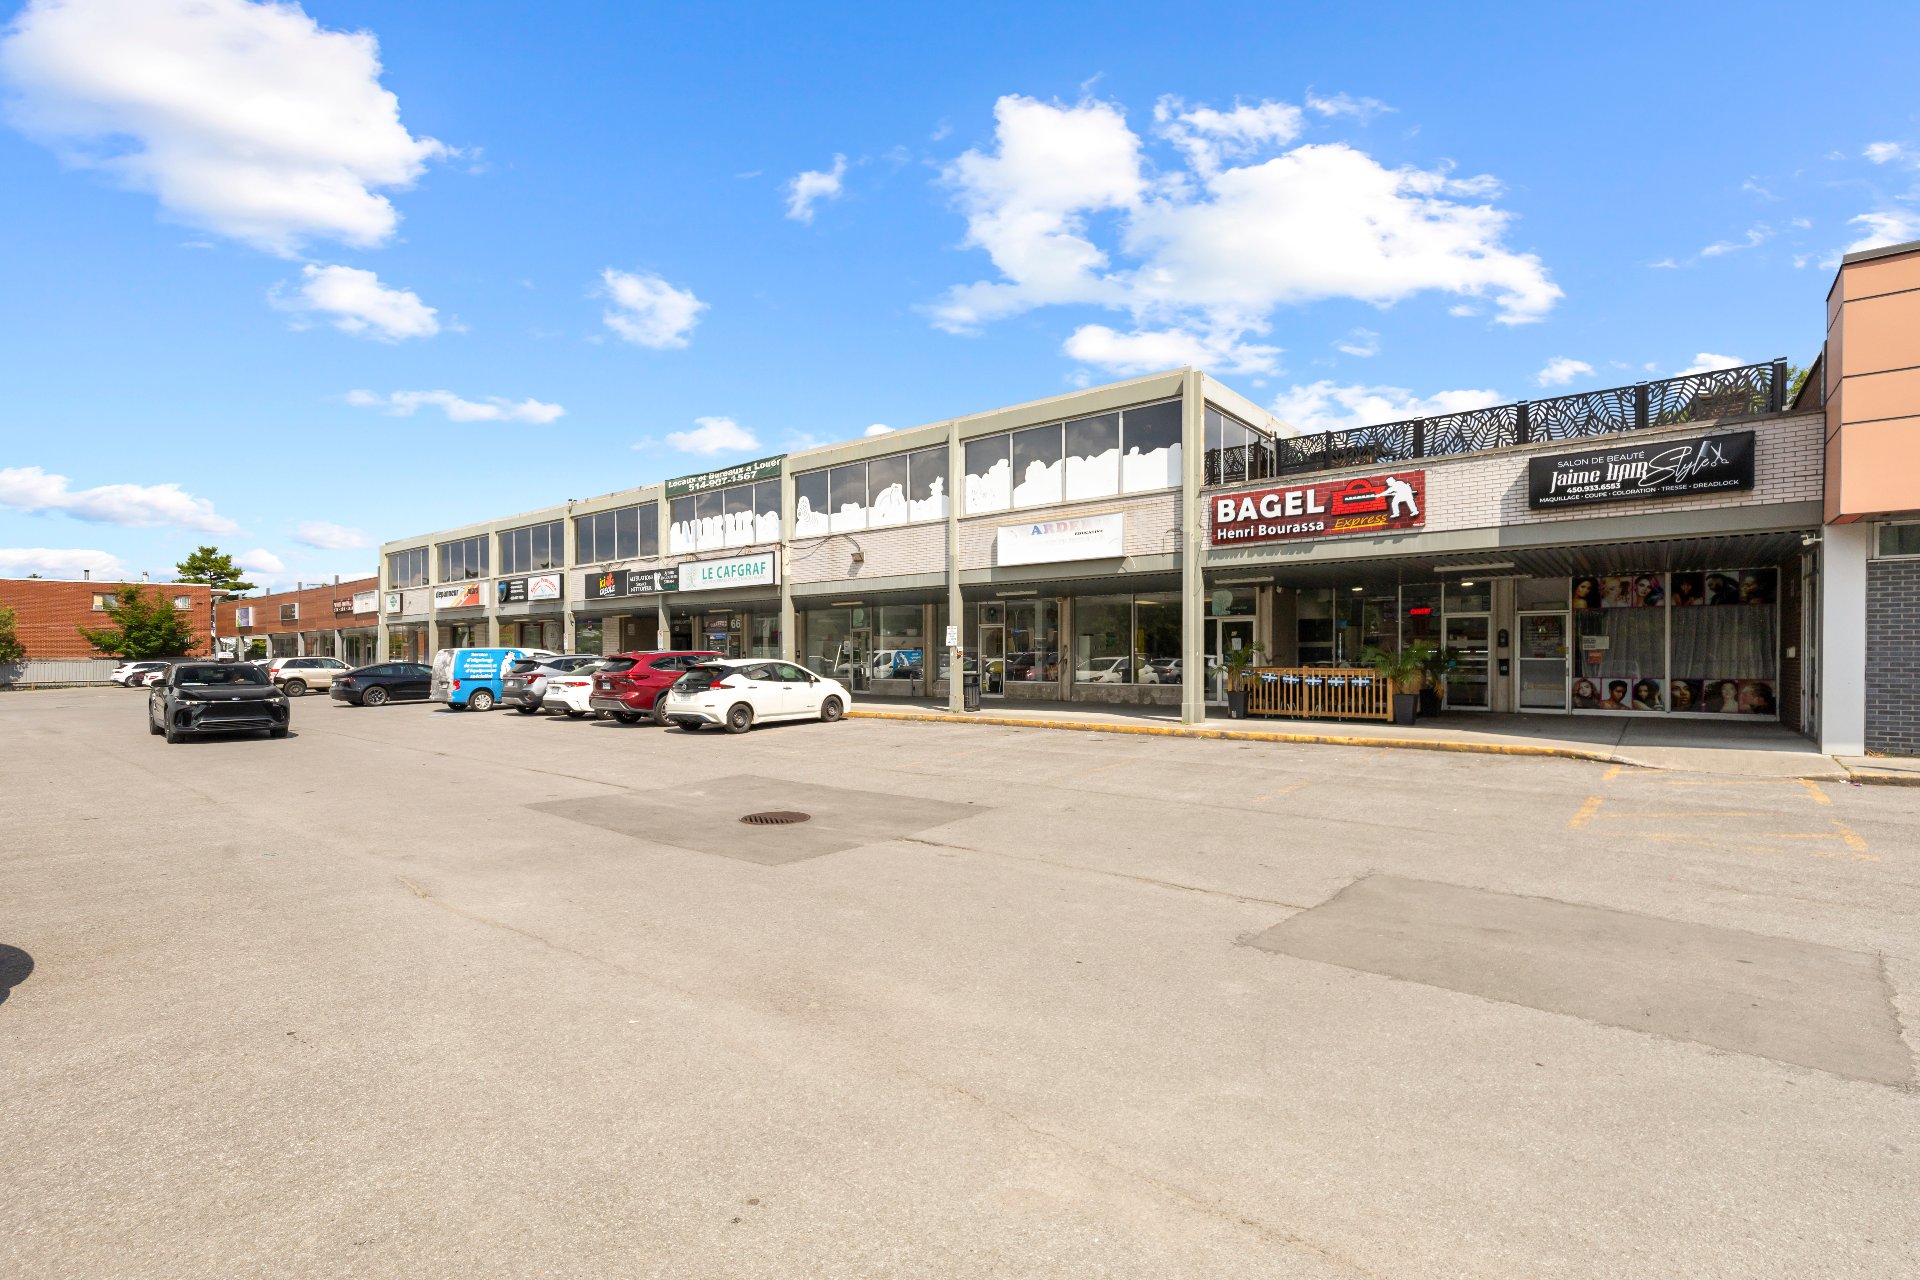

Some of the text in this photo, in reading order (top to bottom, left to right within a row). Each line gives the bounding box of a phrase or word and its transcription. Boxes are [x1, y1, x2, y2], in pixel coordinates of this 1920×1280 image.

[1549, 441, 1711, 493] Jaime HAIR Style
[1557, 450, 1645, 468] SALON DE BEAUTÉ
[668, 477, 696, 489] Locaux
[698, 474, 707, 482] et
[708, 467, 744, 480] Bureaux
[754, 459, 781, 471] Louer
[1539, 479, 1740, 503] MAQUILLAGE COUPE COLORATION TRESSE DREADLOCK
[1217, 489, 1325, 523] BAGEL
[1217, 521, 1325, 540] Henri Bourassa
[1334, 514, 1388, 529] Express
[702, 567, 713, 580] LE
[716, 561, 766, 579] CAFGRAF
